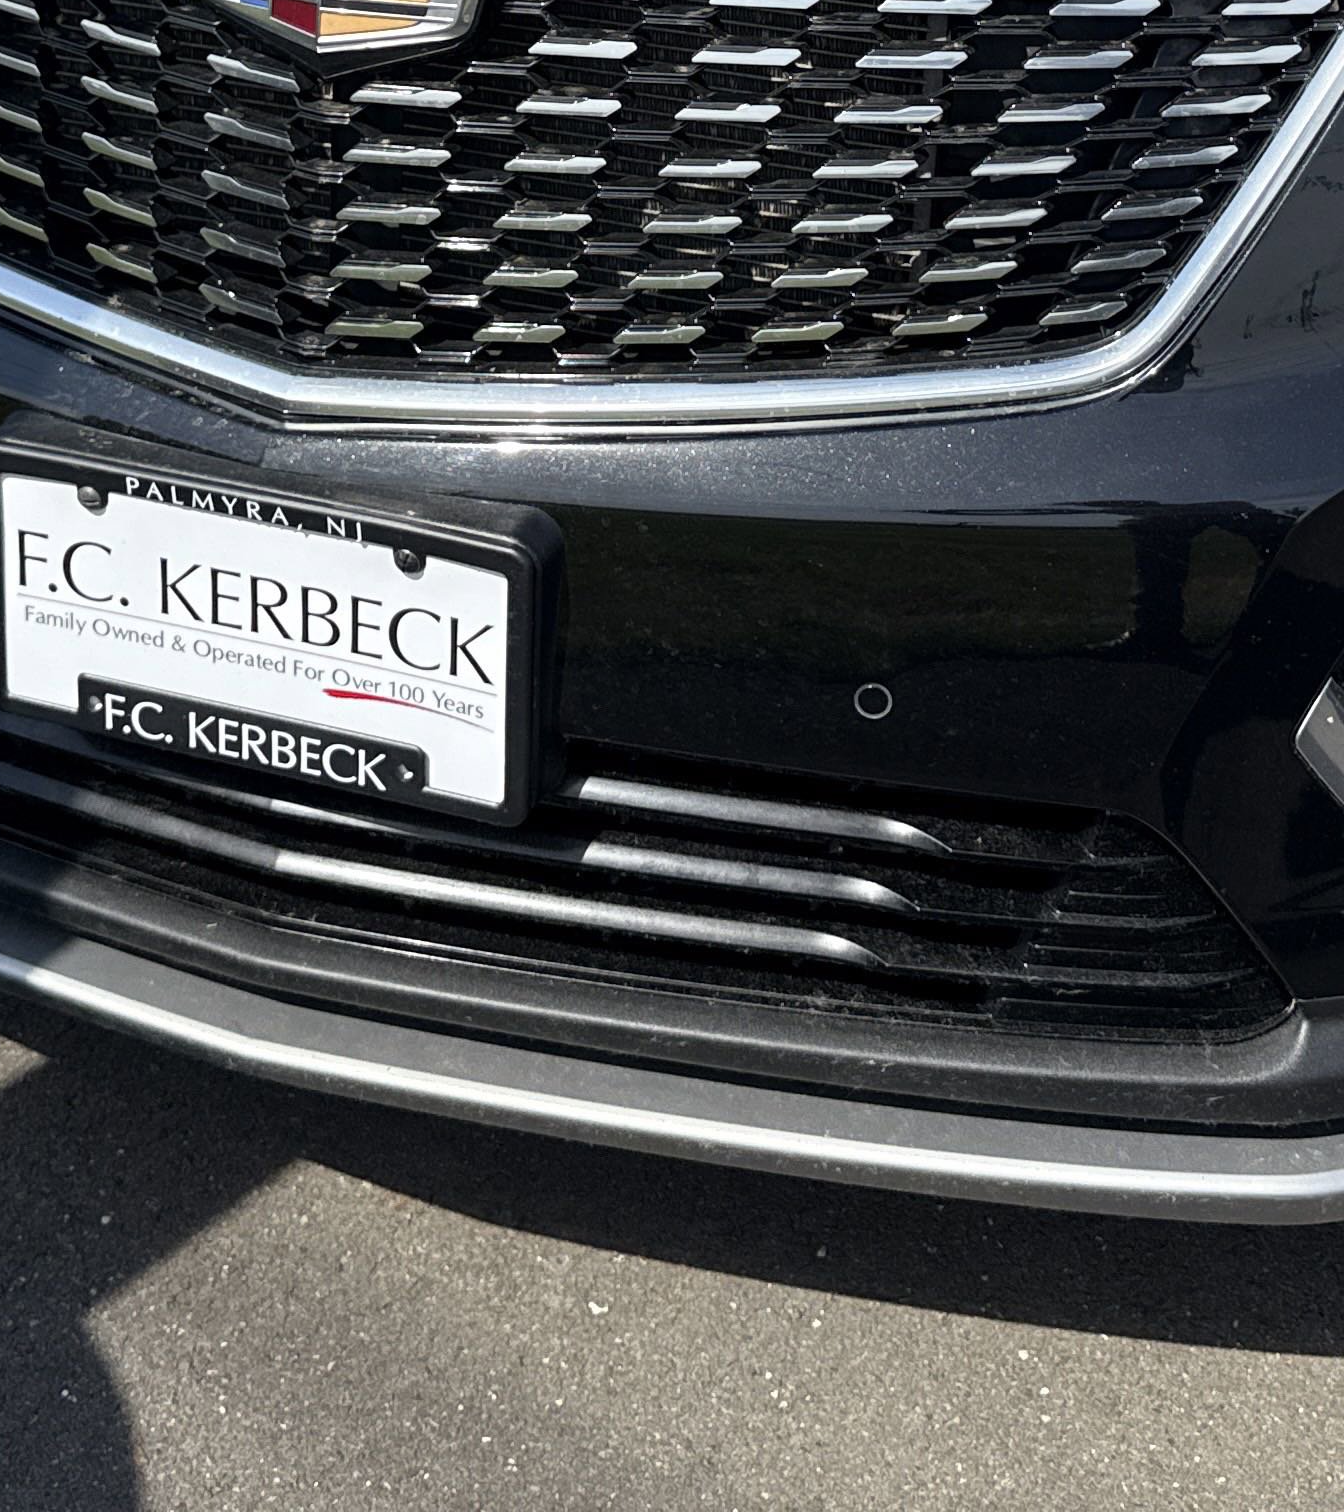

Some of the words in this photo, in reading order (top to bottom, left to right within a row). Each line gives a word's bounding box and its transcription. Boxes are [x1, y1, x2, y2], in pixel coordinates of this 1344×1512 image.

[125, 476, 303, 532] PALMYRA,
[326, 516, 362, 542] NJ
[17, 528, 130, 607] F.C.
[159, 556, 495, 686] KERBECK
[24, 604, 87, 636] Family
[92, 618, 164, 648] Owned
[171, 634, 187, 653] &
[193, 639, 287, 674] Operated
[293, 659, 325, 681] For
[331, 668, 382, 694] Over
[389, 680, 425, 704] 100
[432, 689, 485, 720] Years
[104, 692, 174, 744] F.C.
[188, 711, 387, 792] KERBECK
